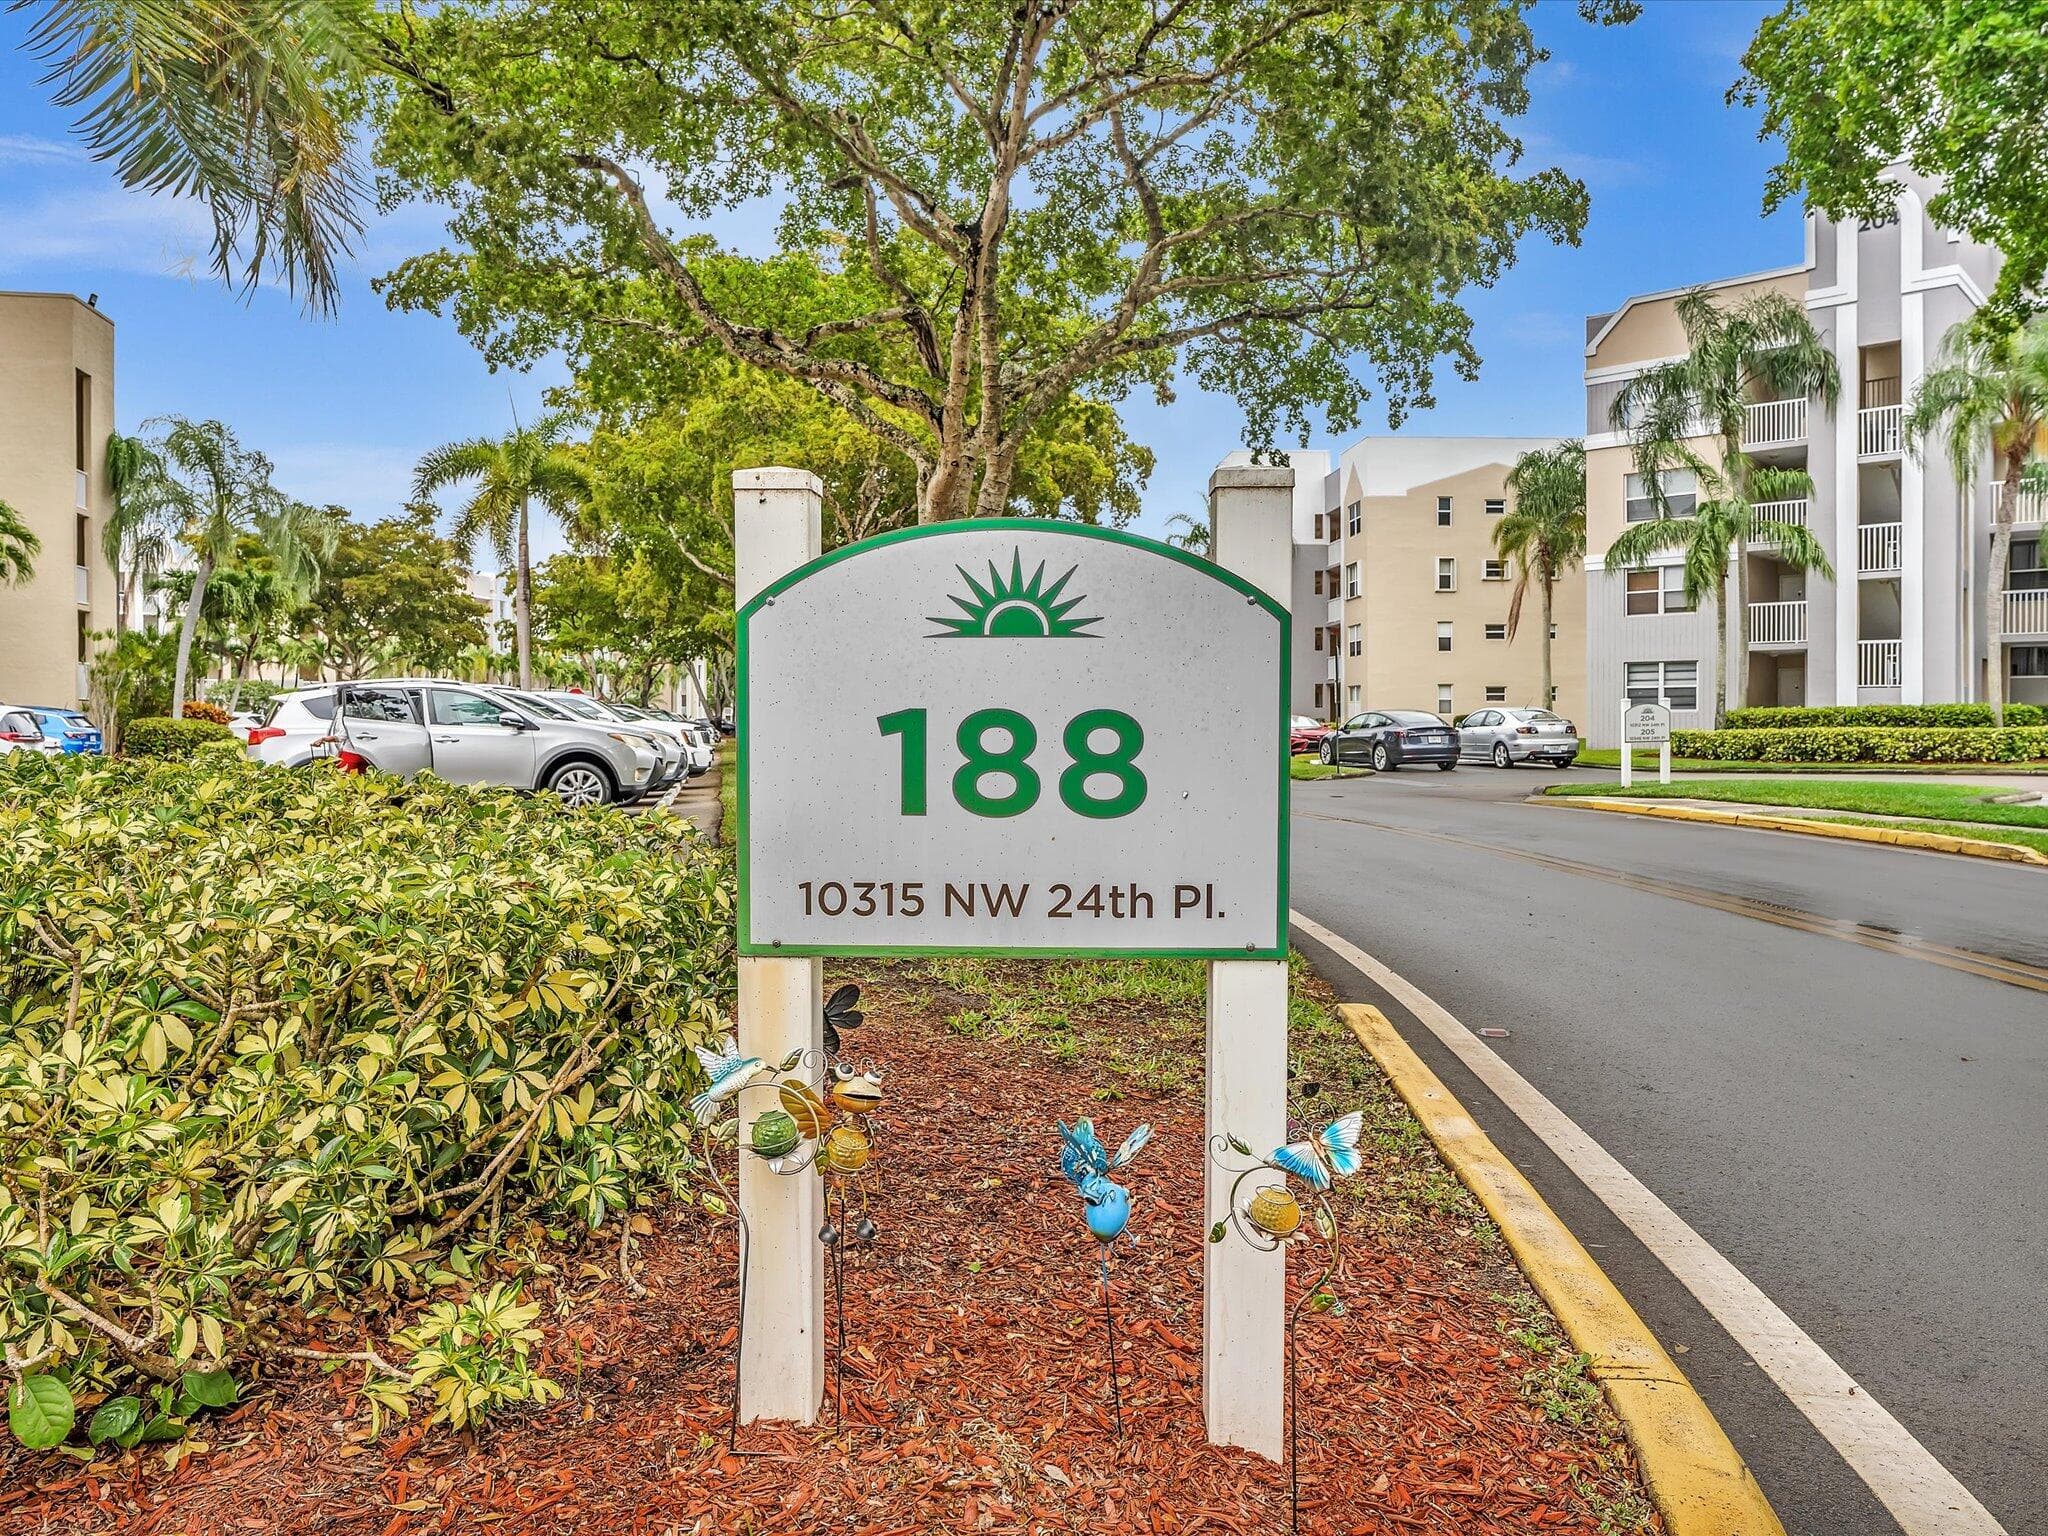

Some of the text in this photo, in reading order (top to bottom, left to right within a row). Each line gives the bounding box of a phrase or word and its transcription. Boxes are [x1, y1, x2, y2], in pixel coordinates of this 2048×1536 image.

[877, 708, 1148, 819] 188
[798, 881, 1226, 919] 10315 NW 24th Pl.
